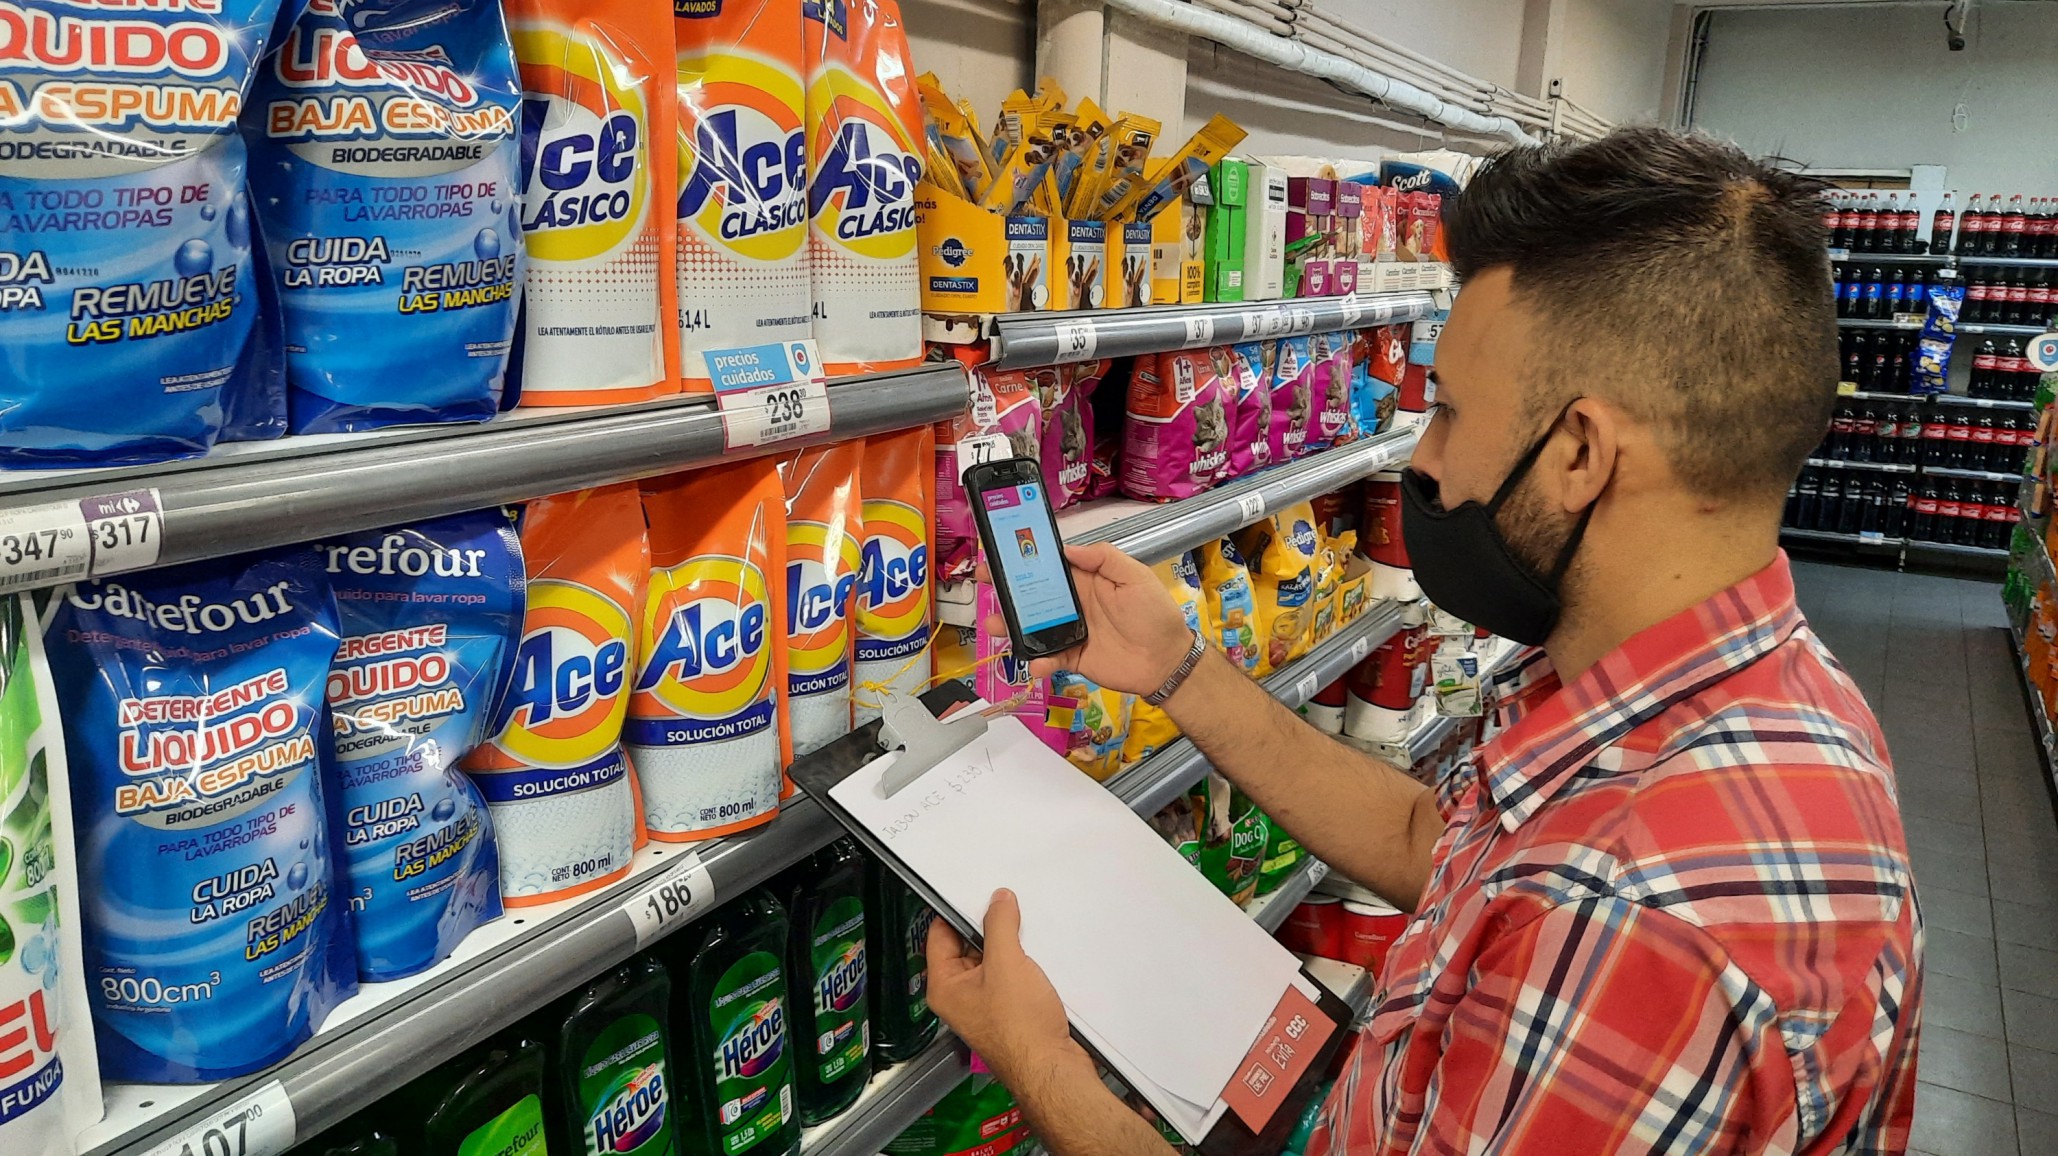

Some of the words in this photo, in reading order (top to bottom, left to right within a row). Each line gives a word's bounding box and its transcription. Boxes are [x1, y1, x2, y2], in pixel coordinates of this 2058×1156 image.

[674, 1, 717, 12] LAVADOS
[41, 86, 242, 122] ESPUMA
[271, 101, 373, 133] BAJA
[386, 102, 513, 134] ESPUMA
[332, 145, 482, 164] BIODEGRADABLE
[677, 109, 806, 220] Ace
[808, 122, 922, 218] Ace
[1391, 169, 1432, 192] Scott
[25, 188, 104, 209] TODO
[113, 186, 173, 207] TIPO
[181, 184, 210, 204] DE
[306, 188, 363, 206] PARA
[371, 186, 429, 204] TODO
[434, 183, 474, 201] TIPO
[478, 182, 497, 198] DE
[913, 197, 937, 210] más
[0, 208, 173, 233] AVARROPAS
[344, 202, 474, 222] LAVARROPAS
[721, 198, 806, 239] CLÁSICO
[1008, 223, 1046, 236] DENTASTIX
[288, 236, 389, 264] CUIDA
[931, 245, 975, 259] Pedigree
[285, 268, 312, 287] LA
[318, 267, 382, 285] ROPA
[402, 253, 516, 292] REMUEVE
[932, 280, 976, 290] DENTASTIX
[0, 287, 41, 309] PA
[70, 265, 236, 318] REMUEVE
[399, 293, 439, 313] LAS
[443, 281, 513, 308] MANCHAS
[67, 319, 121, 343] LAS
[128, 298, 232, 337] MANCHAS
[685, 308, 701, 332] 1,4
[704, 308, 711, 329] L
[713, 350, 760, 372] precios
[720, 366, 776, 386] cuidados
[994, 382, 1025, 395] Carne
[1189, 450, 1228, 475] whiskas
[99, 500, 116, 516] mi
[2, 528, 58, 566] 347
[60, 528, 74, 540] 90
[313, 535, 486, 578] refour
[856, 538, 927, 609] Ace
[374, 591, 410, 604] para
[412, 591, 449, 603] lavar
[452, 593, 487, 605] ropa
[231, 633, 270, 653] lavar
[273, 625, 312, 643] ropa
[635, 602, 765, 691] Ace
[858, 641, 909, 659] SOLUCIÓN
[497, 630, 627, 734] Ace
[788, 677, 827, 695] UCIÓN
[827, 670, 848, 687] TOTAL
[122, 670, 286, 724] DETERGENTE
[358, 691, 463, 727] ESPUMA
[123, 702, 295, 773] LIQUIDO
[666, 721, 736, 743] SOLUCIÓN
[736, 713, 768, 734] TOTAL
[118, 779, 193, 810] BAJA
[199, 738, 316, 793] ESPUMA
[355, 759, 391, 778] TODO
[513, 771, 592, 798] SOLUCIÓN
[592, 760, 626, 784] TOTAL
[165, 777, 284, 826] BIODEGRADABLE
[347, 793, 424, 828] CUIDA
[699, 806, 718, 816] CONT.
[700, 813, 719, 822] NETO
[718, 803, 741, 818] 800
[741, 799, 755, 813] ml
[157, 837, 198, 856] PARA
[203, 825, 243, 846] TODO
[246, 810, 276, 831] TIPO
[278, 803, 297, 818] DE
[184, 822, 278, 862] LAVARROPAS
[346, 829, 368, 844] LA
[372, 816, 420, 839] ROPA
[1234, 830, 1254, 849] DOG
[193, 858, 278, 904] CUIDA
[393, 861, 425, 881] LAS
[551, 866, 572, 877] CONT.
[552, 873, 571, 883] NETO
[572, 860, 597, 878] 800
[597, 853, 612, 870] ml
[191, 904, 216, 922] LA
[222, 883, 274, 915] ROPA
[245, 934, 280, 961] LAS
[820, 949, 866, 1012] Héroe
[1284, 1014, 1308, 1040] CCC
[723, 1007, 783, 1078] Héroe
[1271, 1042, 1297, 1071] Evita
[245, 1103, 263, 1122] 00
[594, 1074, 664, 1154] Héroe
